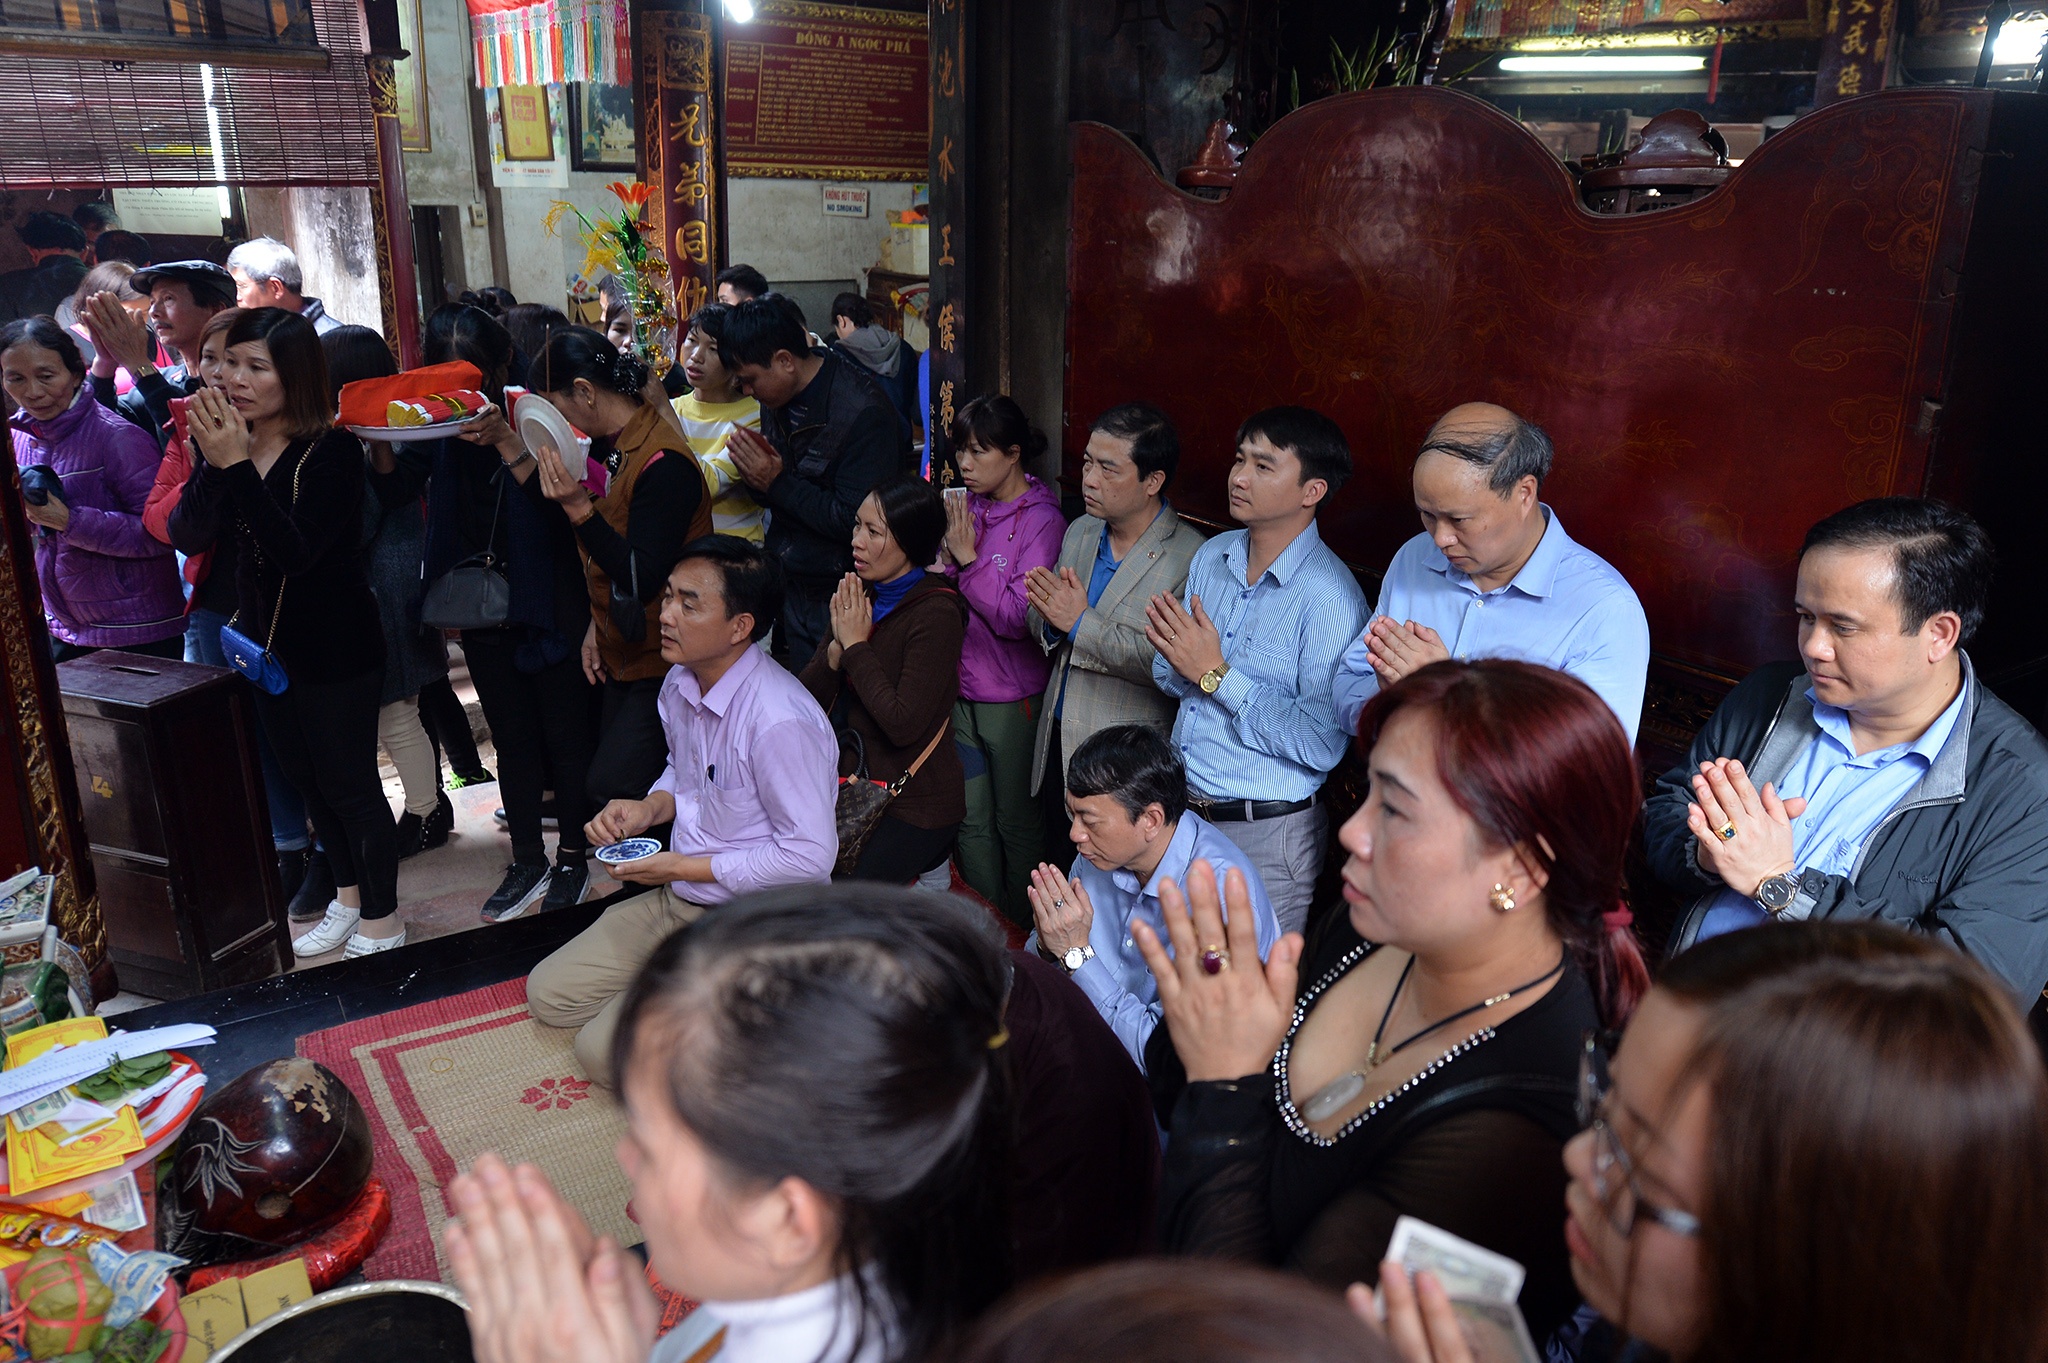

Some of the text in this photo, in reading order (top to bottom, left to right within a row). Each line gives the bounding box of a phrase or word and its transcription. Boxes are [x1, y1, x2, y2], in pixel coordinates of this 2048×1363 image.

[796, 30, 832, 46] ĐÔNG
[849, 36, 883, 52] NGỌC
[885, 38, 911, 54] PHẢ
[827, 204, 863, 213] NO SMOKING
